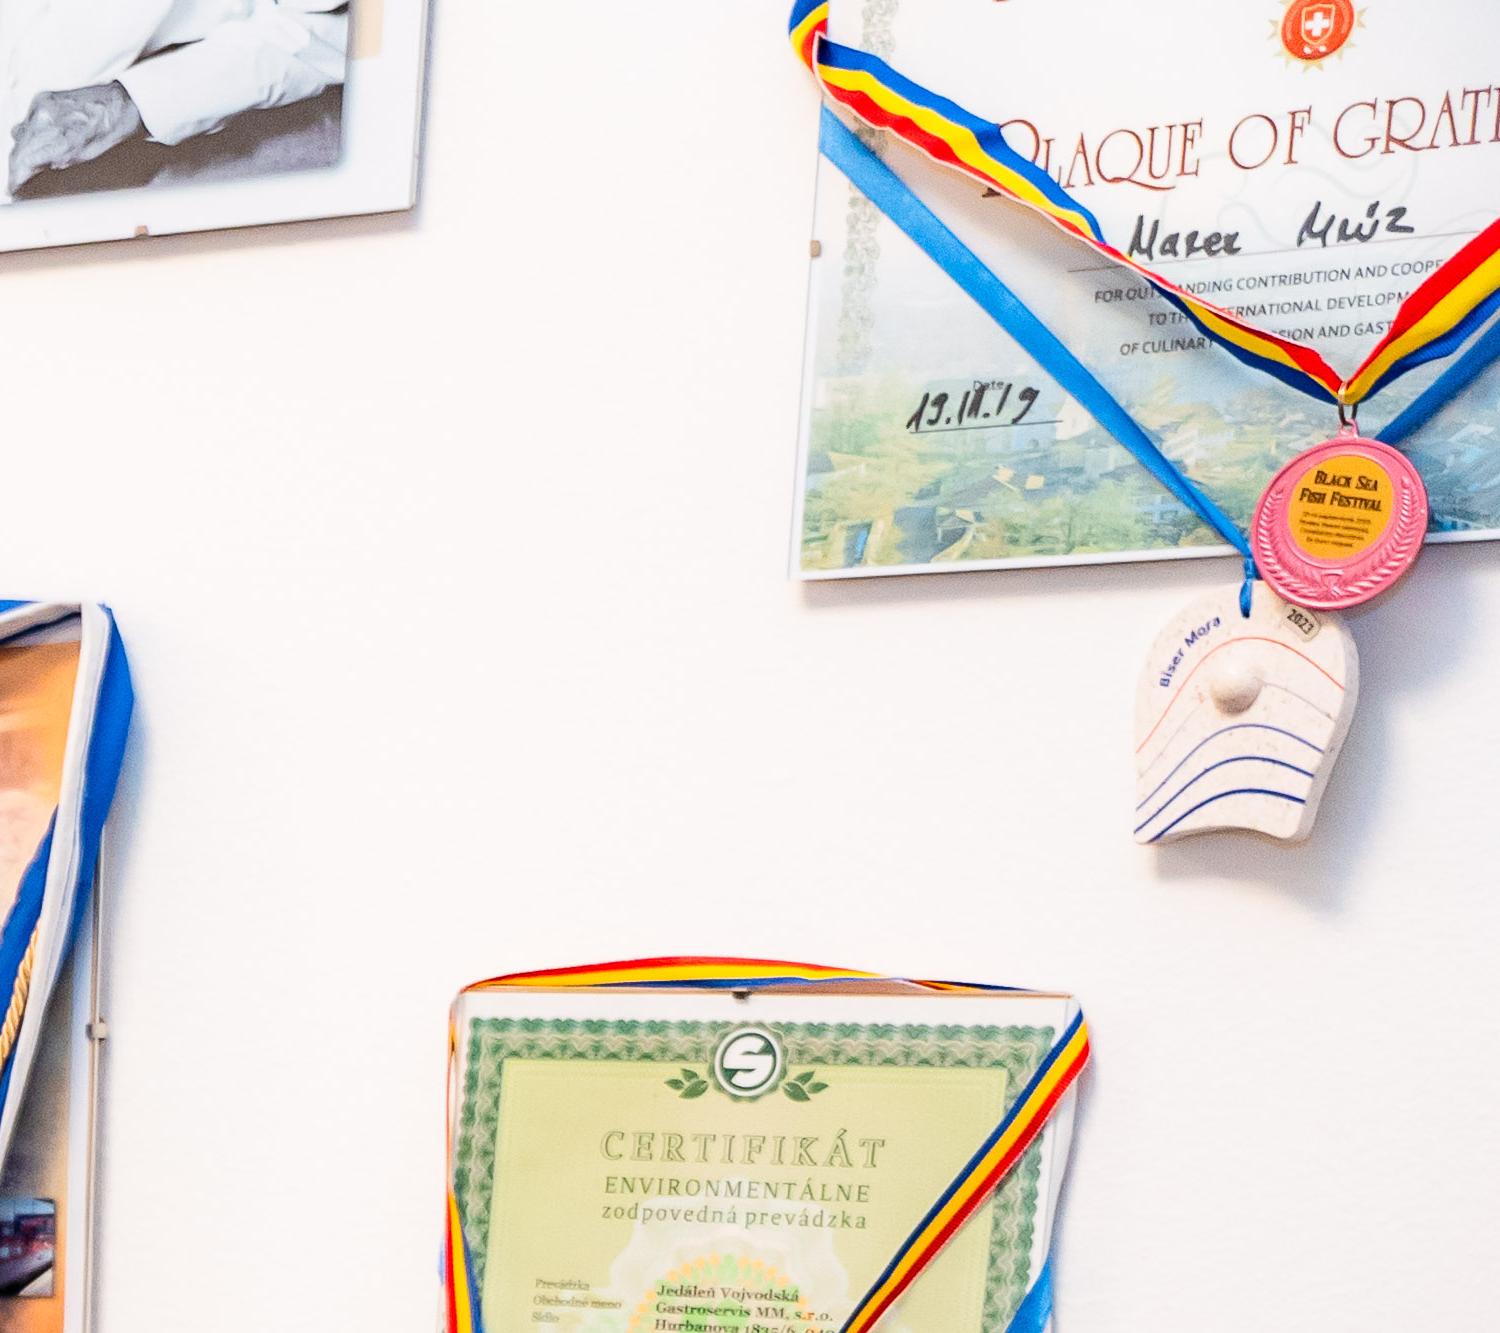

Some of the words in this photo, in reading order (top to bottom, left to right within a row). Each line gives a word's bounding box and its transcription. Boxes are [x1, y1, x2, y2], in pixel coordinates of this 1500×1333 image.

[1228, 105, 1311, 169] OF
[1334, 84, 1500, 159] GRATI
[1095, 288, 1124, 304] FOR
[1236, 268, 1351, 293] CONTRIBUTION
[1355, 263, 1388, 280] AND
[1149, 311, 1167, 327] TO
[1120, 341, 1139, 357] OF
[1317, 323, 1350, 340] AND
[1315, 470, 1352, 488] BLACK
[1355, 475, 1378, 491] SEA
[1300, 487, 1327, 504] FISH
[1330, 491, 1382, 512] FESTIVAL
[1159, 647, 1185, 688] Biser
[1184, 615, 1222, 648] Mora
[600, 1127, 886, 1169] CERTIFIKÁT
[604, 1175, 871, 1204] ENVIRONMENTÁLNE
[601, 1201, 738, 1227] zodpovedná
[744, 1207, 868, 1231] prevádzka
[655, 1301, 751, 1319] Gastroservis
[720, 1286, 800, 1306] Vojvodská
